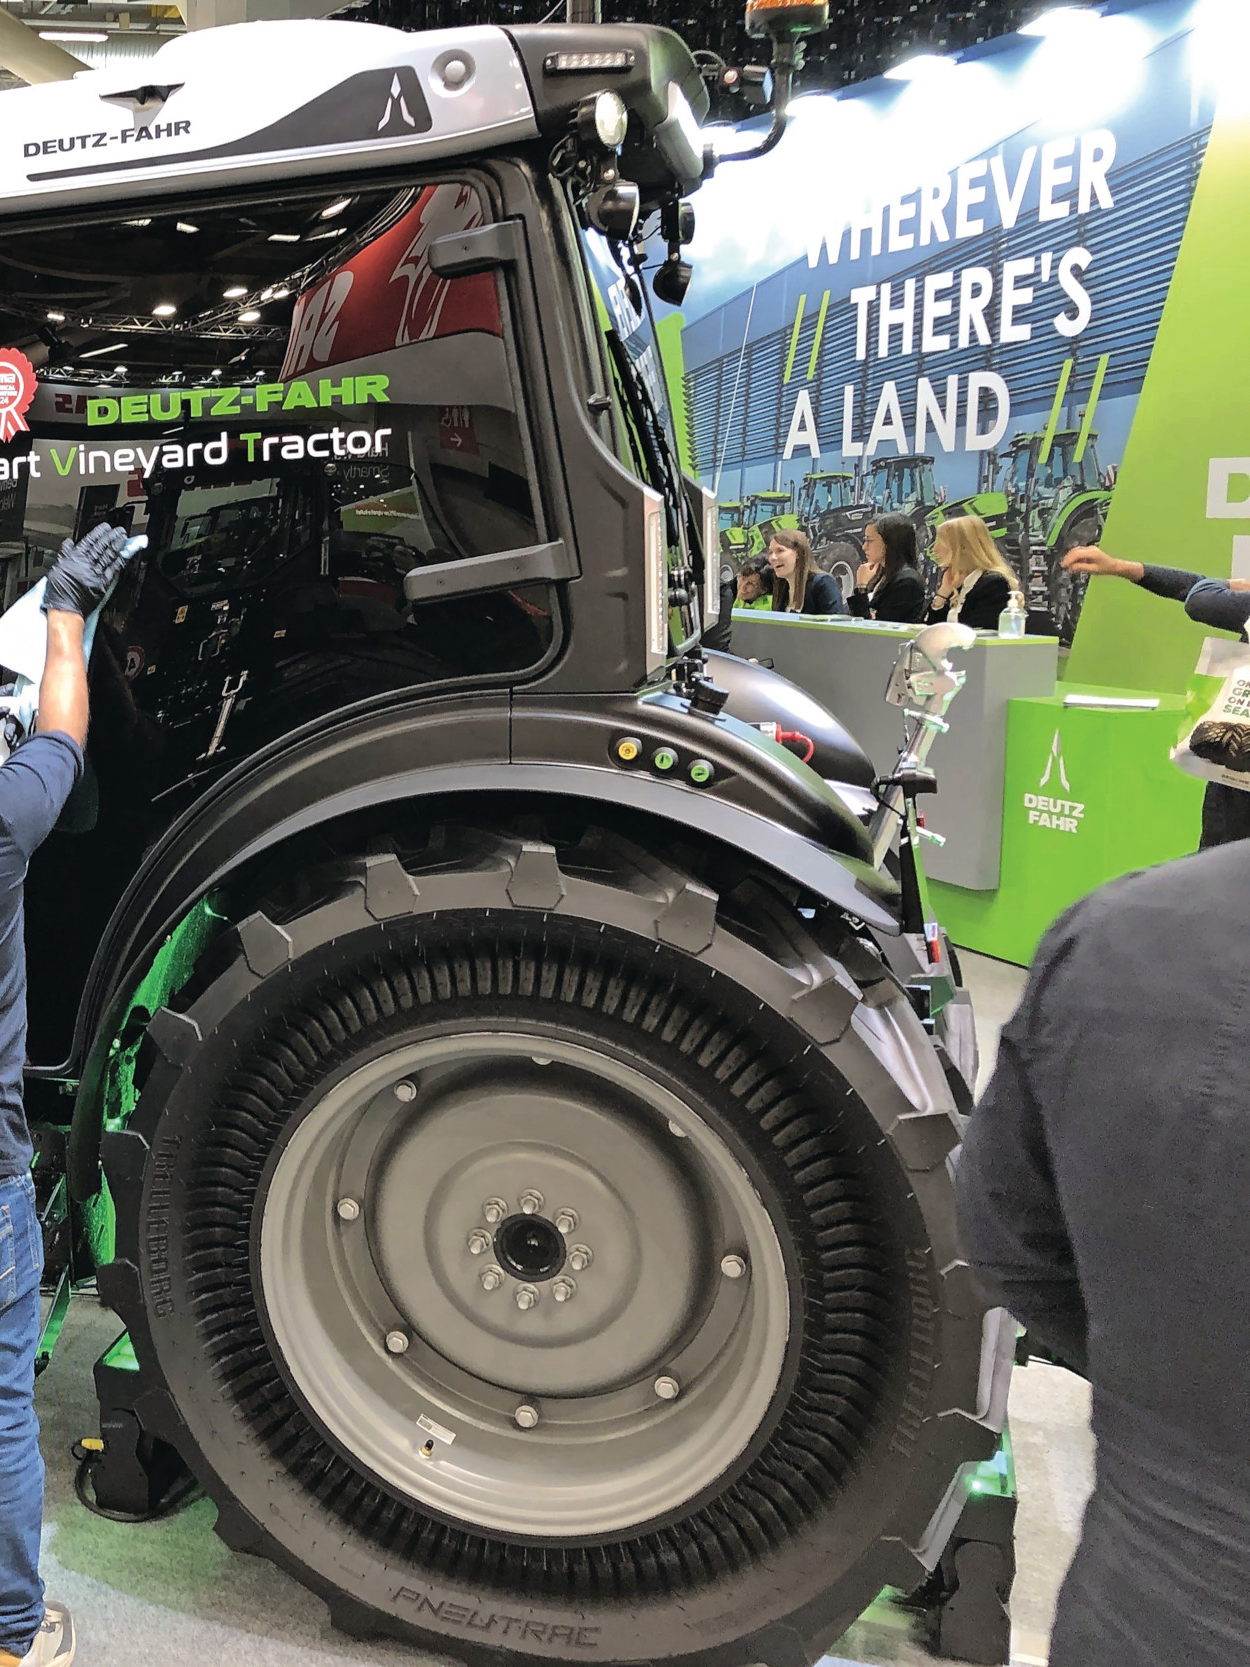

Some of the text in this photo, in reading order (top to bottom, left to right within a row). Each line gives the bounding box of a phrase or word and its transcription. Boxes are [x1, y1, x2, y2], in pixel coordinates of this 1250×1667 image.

[23, 120, 192, 158] DEUTZ-FAHR
[807, 129, 1117, 269] WHEREVER
[850, 246, 1094, 361] THERE'S
[86, 374, 391, 427] DEUTZ-FAHR
[782, 371, 1011, 460] A LAND
[50, 431, 229, 479] Vineyard
[239, 426, 393, 462] Tractor
[1024, 792, 1085, 818] DEUTZ
[1028, 810, 1079, 834] FAHR
